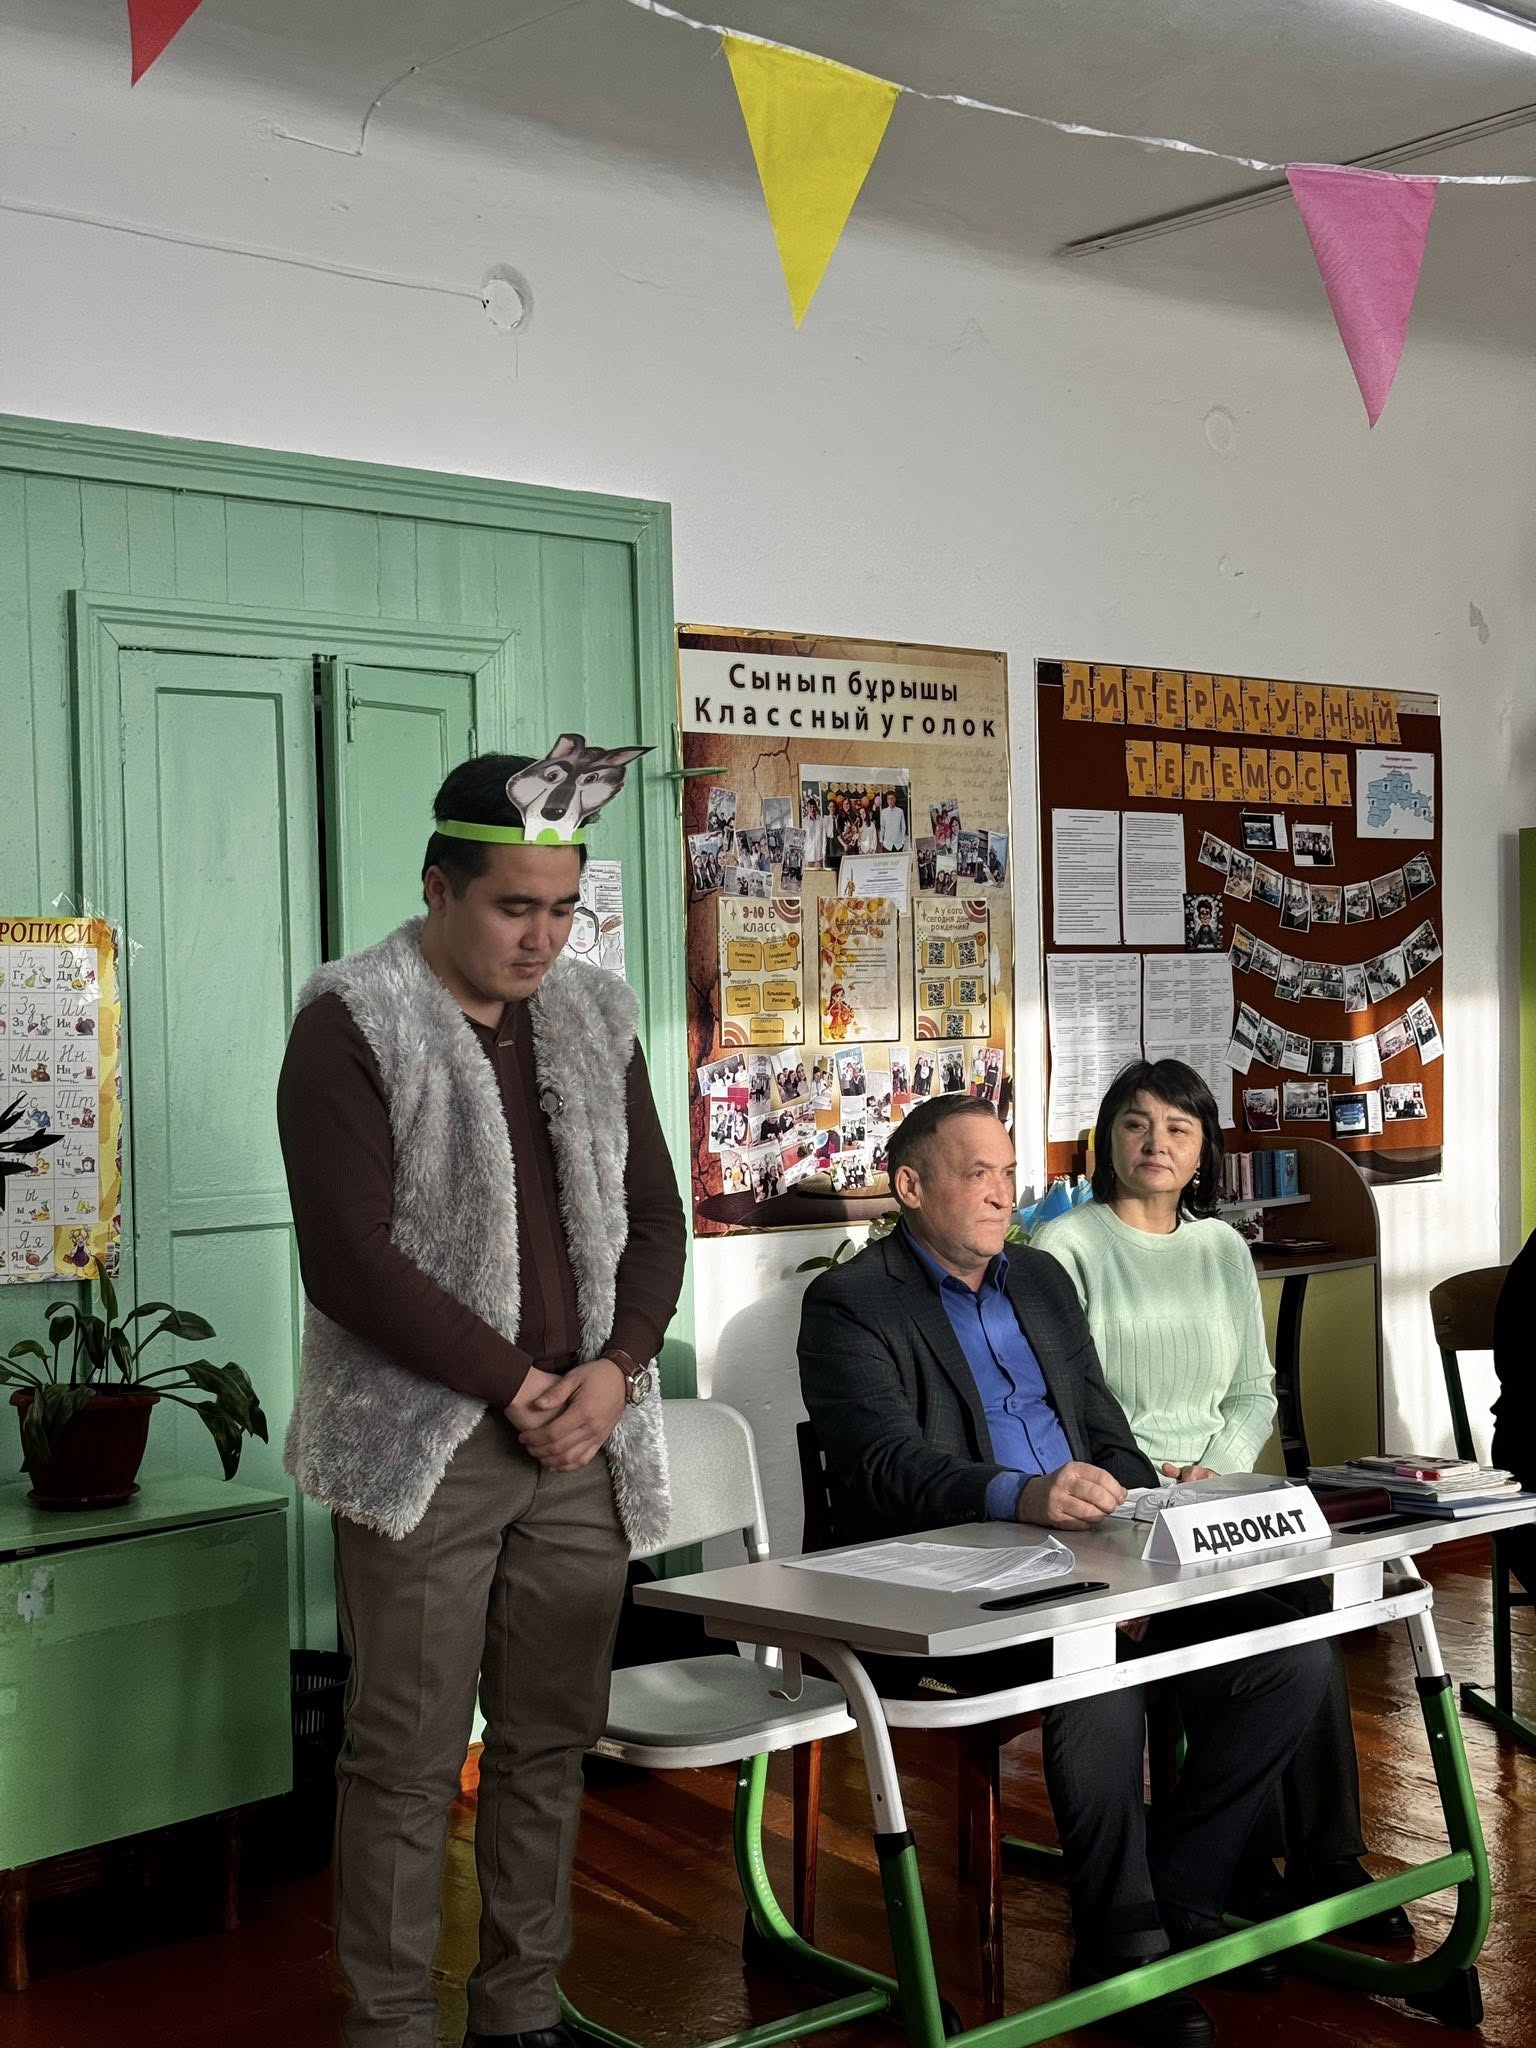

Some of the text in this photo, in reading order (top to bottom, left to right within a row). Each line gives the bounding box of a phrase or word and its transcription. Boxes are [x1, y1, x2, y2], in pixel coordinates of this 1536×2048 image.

[729, 663, 958, 702] Сынып бұрышы
[695, 697, 996, 738] Классный уголок
[1069, 679, 1395, 731] ЛИТЕРАТУРНЫЙ
[1133, 756, 1343, 793] ТЕЛЕМОСТ
[1192, 1508, 1307, 1555] АДВОКАТ
